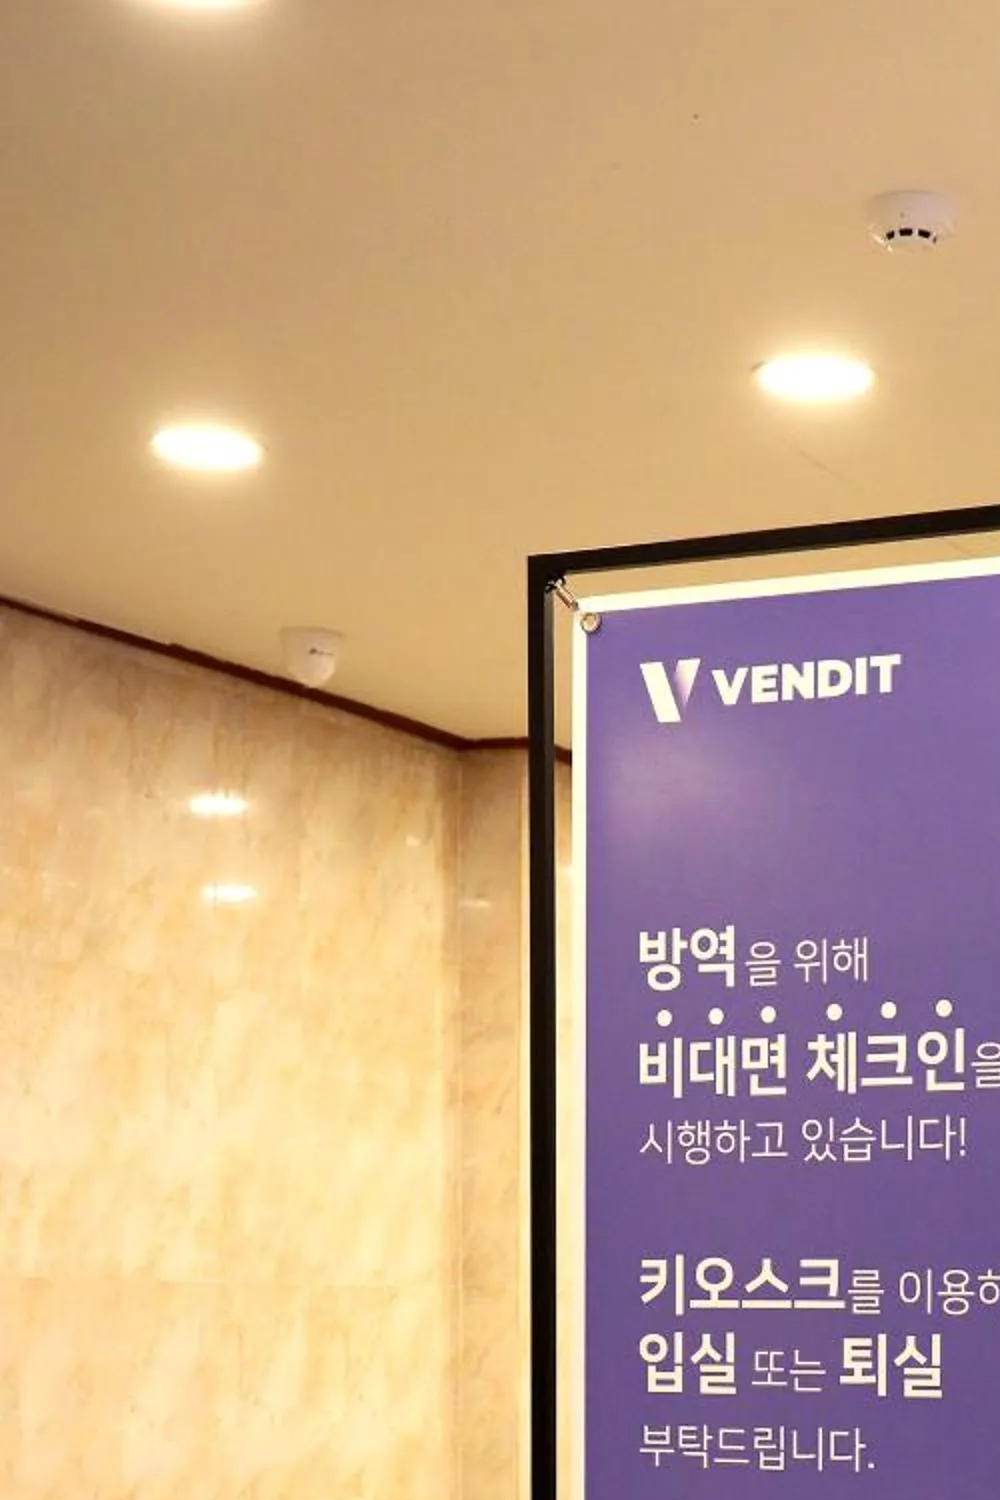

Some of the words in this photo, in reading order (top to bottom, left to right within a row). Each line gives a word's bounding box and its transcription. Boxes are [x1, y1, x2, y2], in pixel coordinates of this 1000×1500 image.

[711, 654, 901, 706] VENDIT
[639, 924, 783, 992] 방역을
[794, 936, 869, 984] 위해
[639, 1032, 788, 1099] 비대면
[639, 1118, 789, 1165] 시행하고
[800, 1113, 967, 1164] 있습니다!
[639, 1253, 885, 1316] 키오스크를
[639, 1331, 737, 1395] 입실
[751, 1349, 827, 1392] 또는
[839, 1333, 943, 1399] 퇴실
[639, 1424, 877, 1473] 부탁드립니다.
